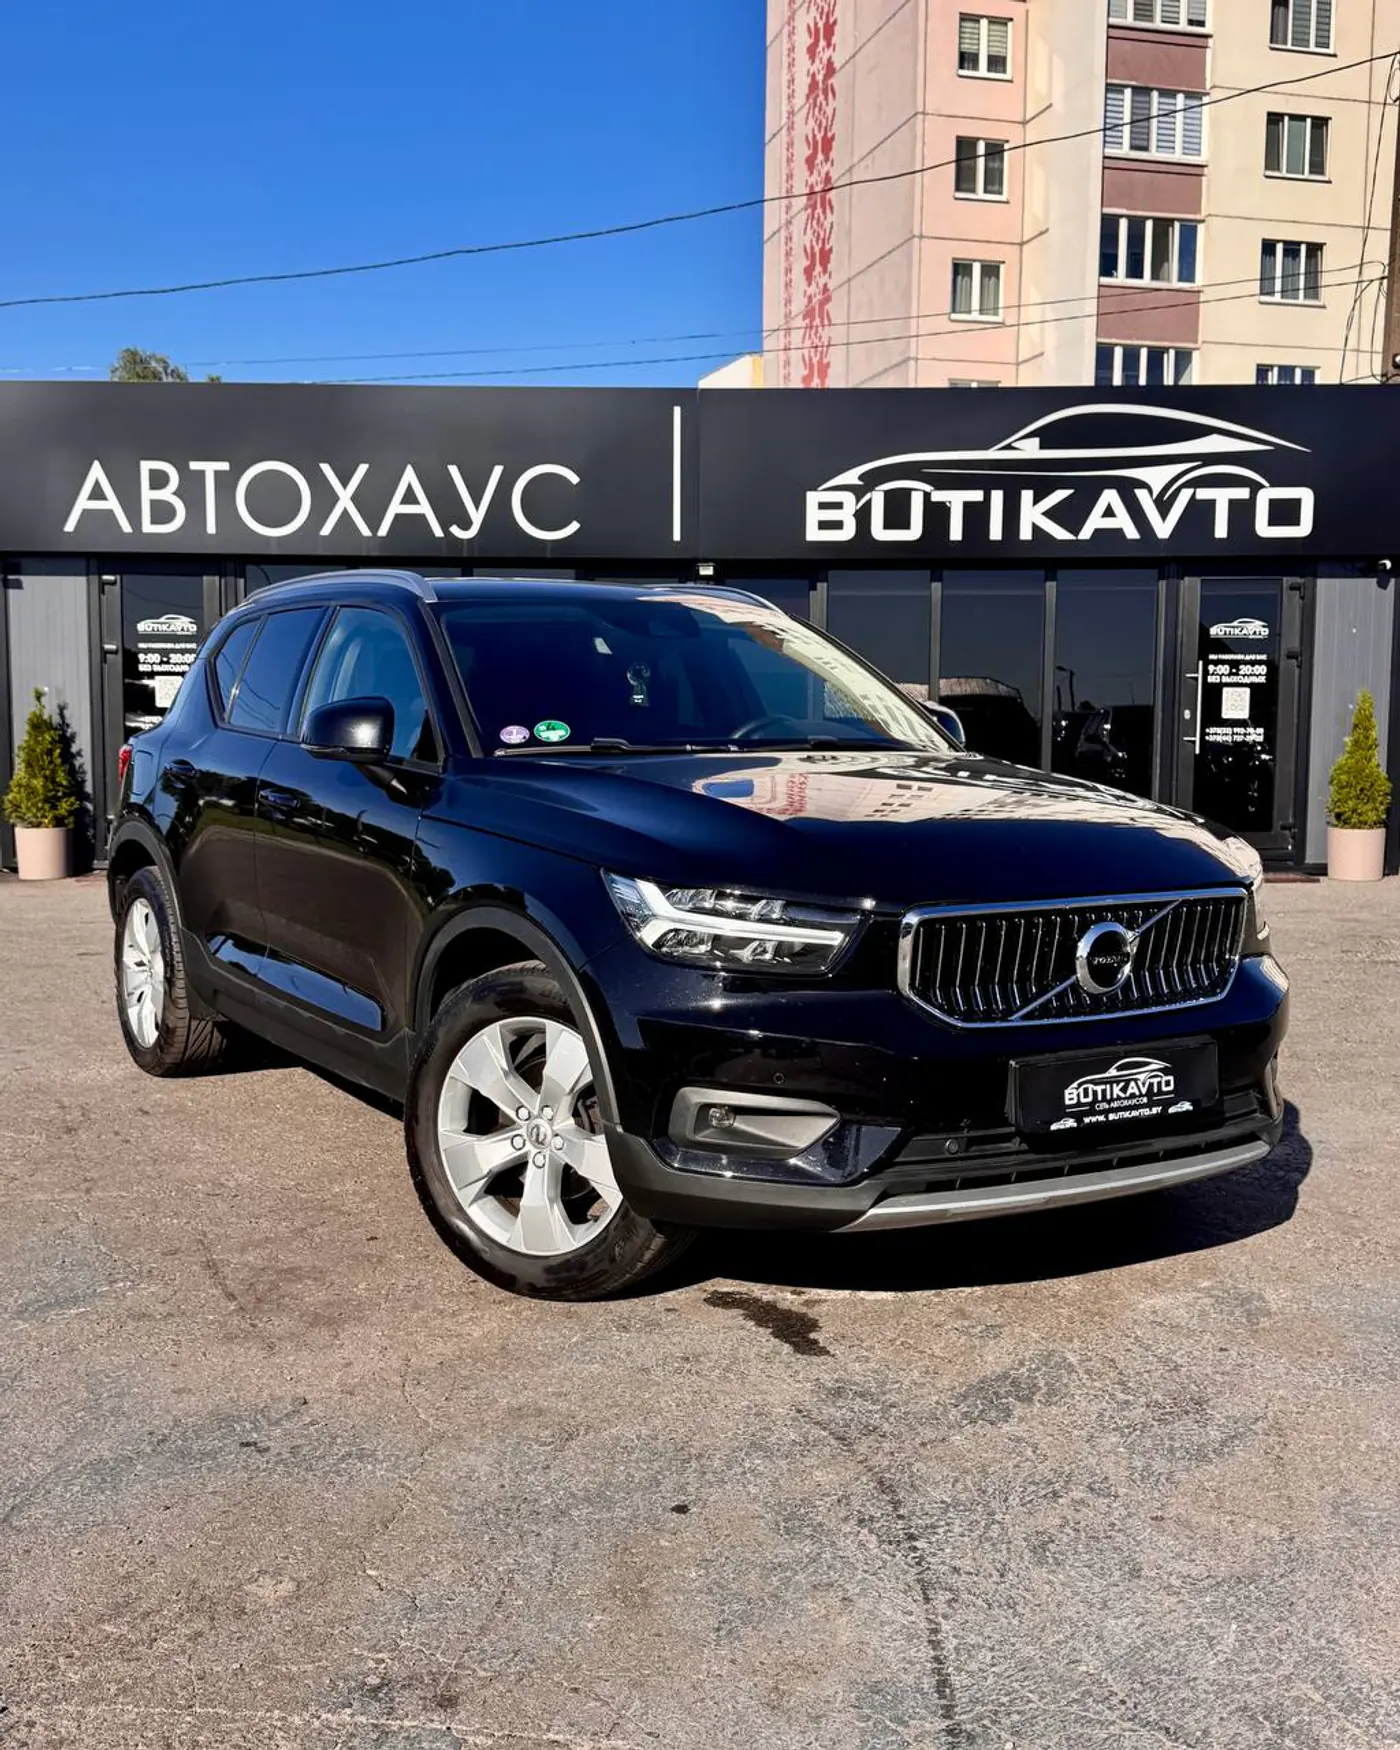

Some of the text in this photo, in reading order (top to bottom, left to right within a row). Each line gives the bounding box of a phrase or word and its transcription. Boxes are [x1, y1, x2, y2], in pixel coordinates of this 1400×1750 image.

[63, 460, 580, 540] АВТОХАУС
[805, 486, 1315, 541] BUTIKAVTO
[1209, 627, 1269, 635] BUTIKAVTO
[138, 653, 161, 663] 9:00
[1208, 664, 1230, 675] 9:00
[1239, 664, 1267, 675] 20:00
[1064, 1076, 1174, 1105] BUTIKAVTO
